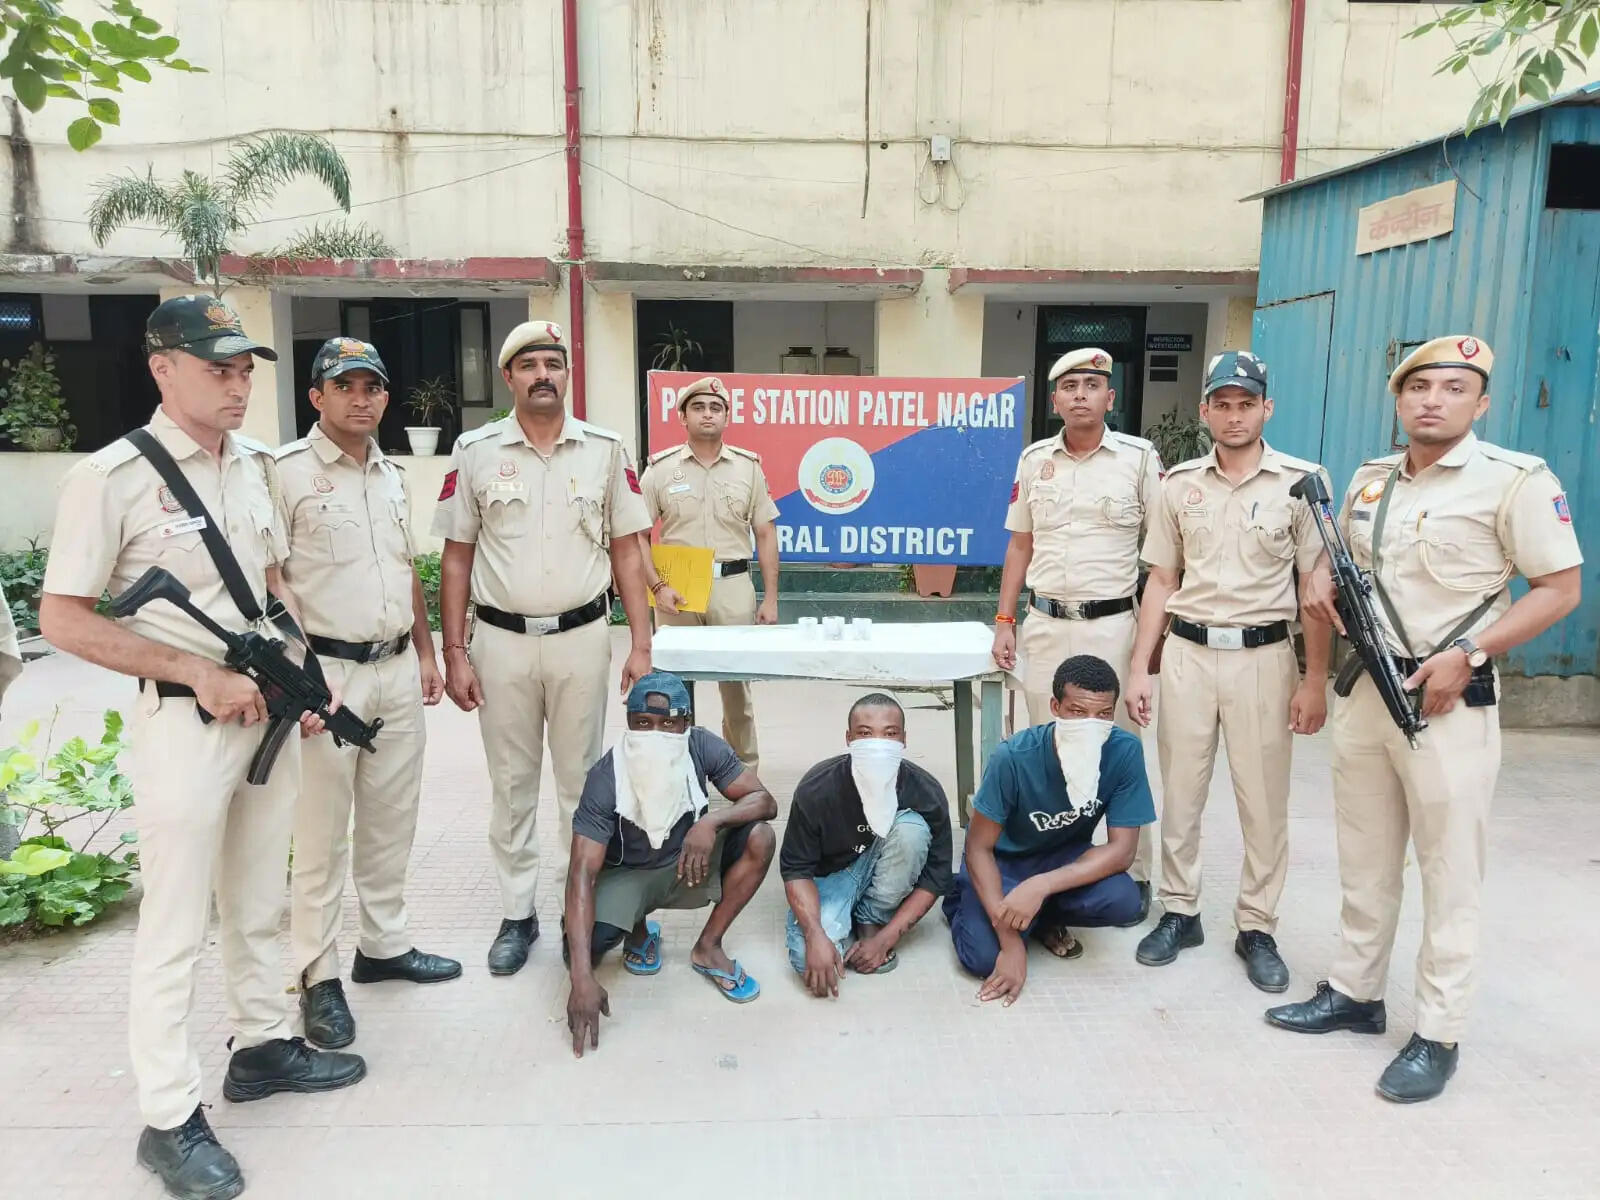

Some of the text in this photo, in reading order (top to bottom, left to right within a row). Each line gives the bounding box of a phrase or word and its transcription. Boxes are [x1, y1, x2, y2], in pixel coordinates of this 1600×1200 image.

[753, 388, 849, 425] STATION
[858, 390, 928, 427] PATEL
[937, 391, 1015, 428] NAGAR
[840, 526, 974, 556] DISTRICT
